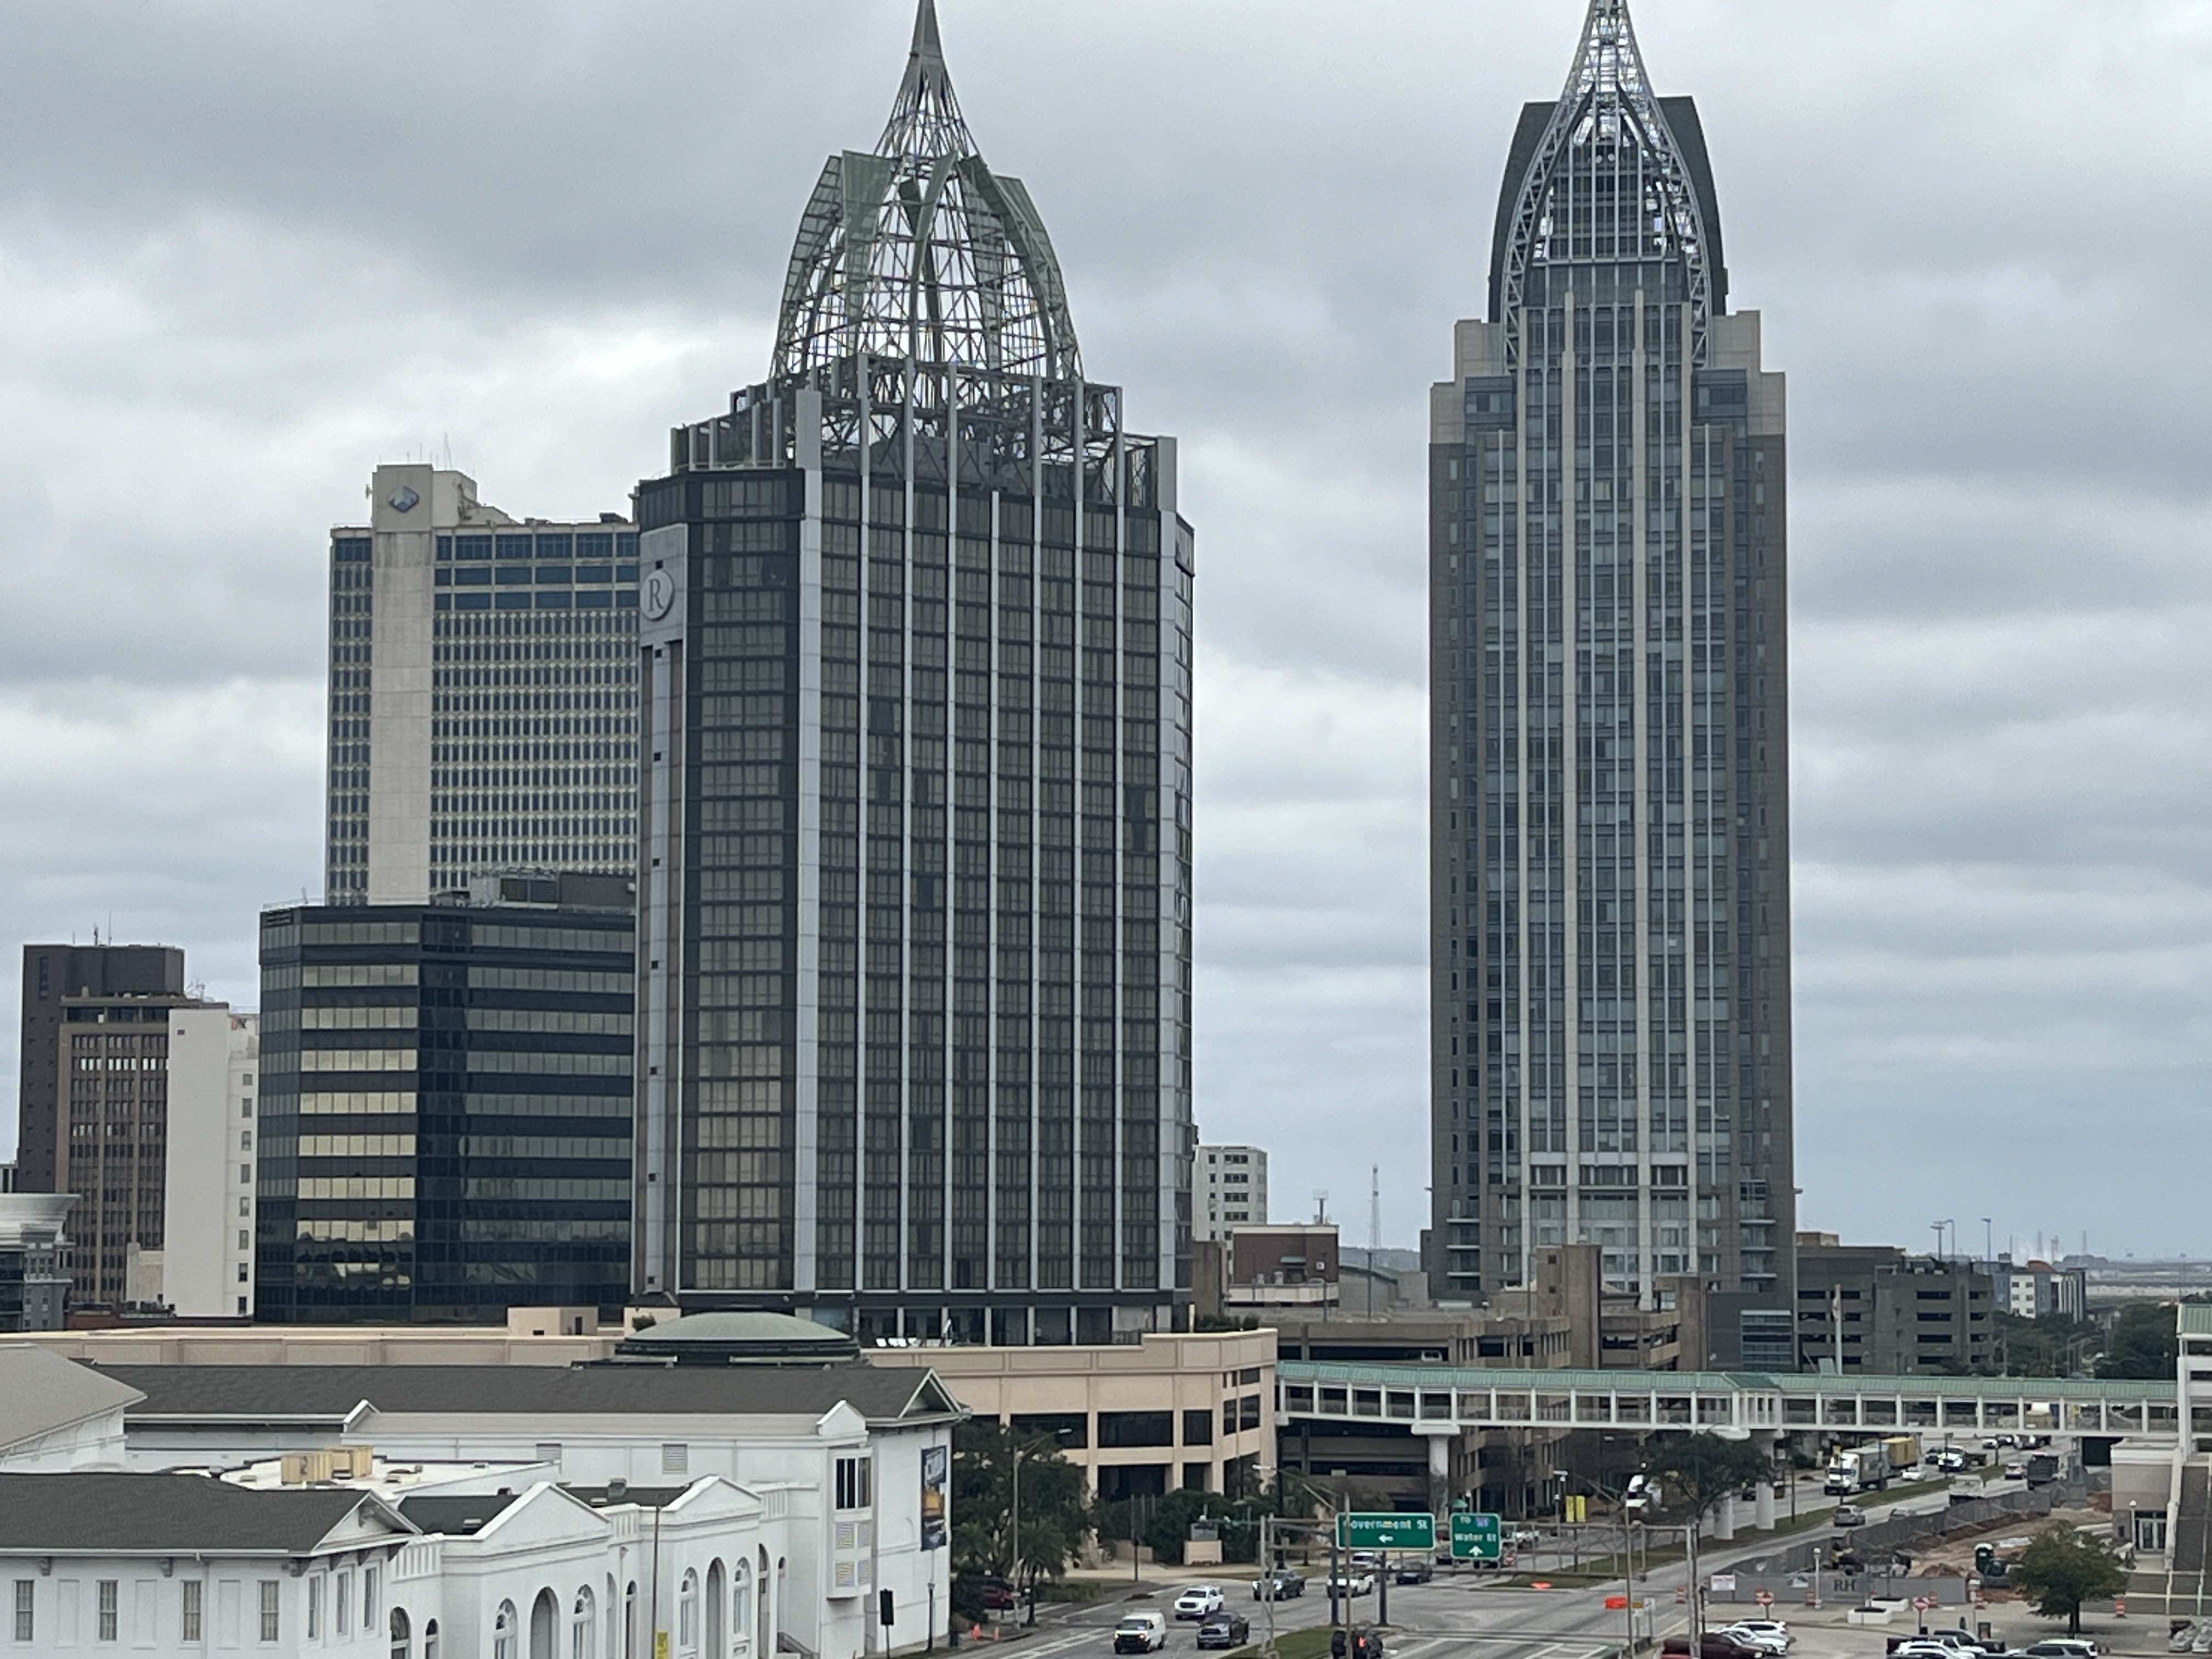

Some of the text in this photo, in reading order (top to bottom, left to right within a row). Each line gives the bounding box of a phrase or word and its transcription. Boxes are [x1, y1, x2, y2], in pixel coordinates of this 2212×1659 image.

[648, 578, 664, 612] R
[1417, 1519, 1427, 1530] St
[1454, 1533, 1483, 1542] Water
